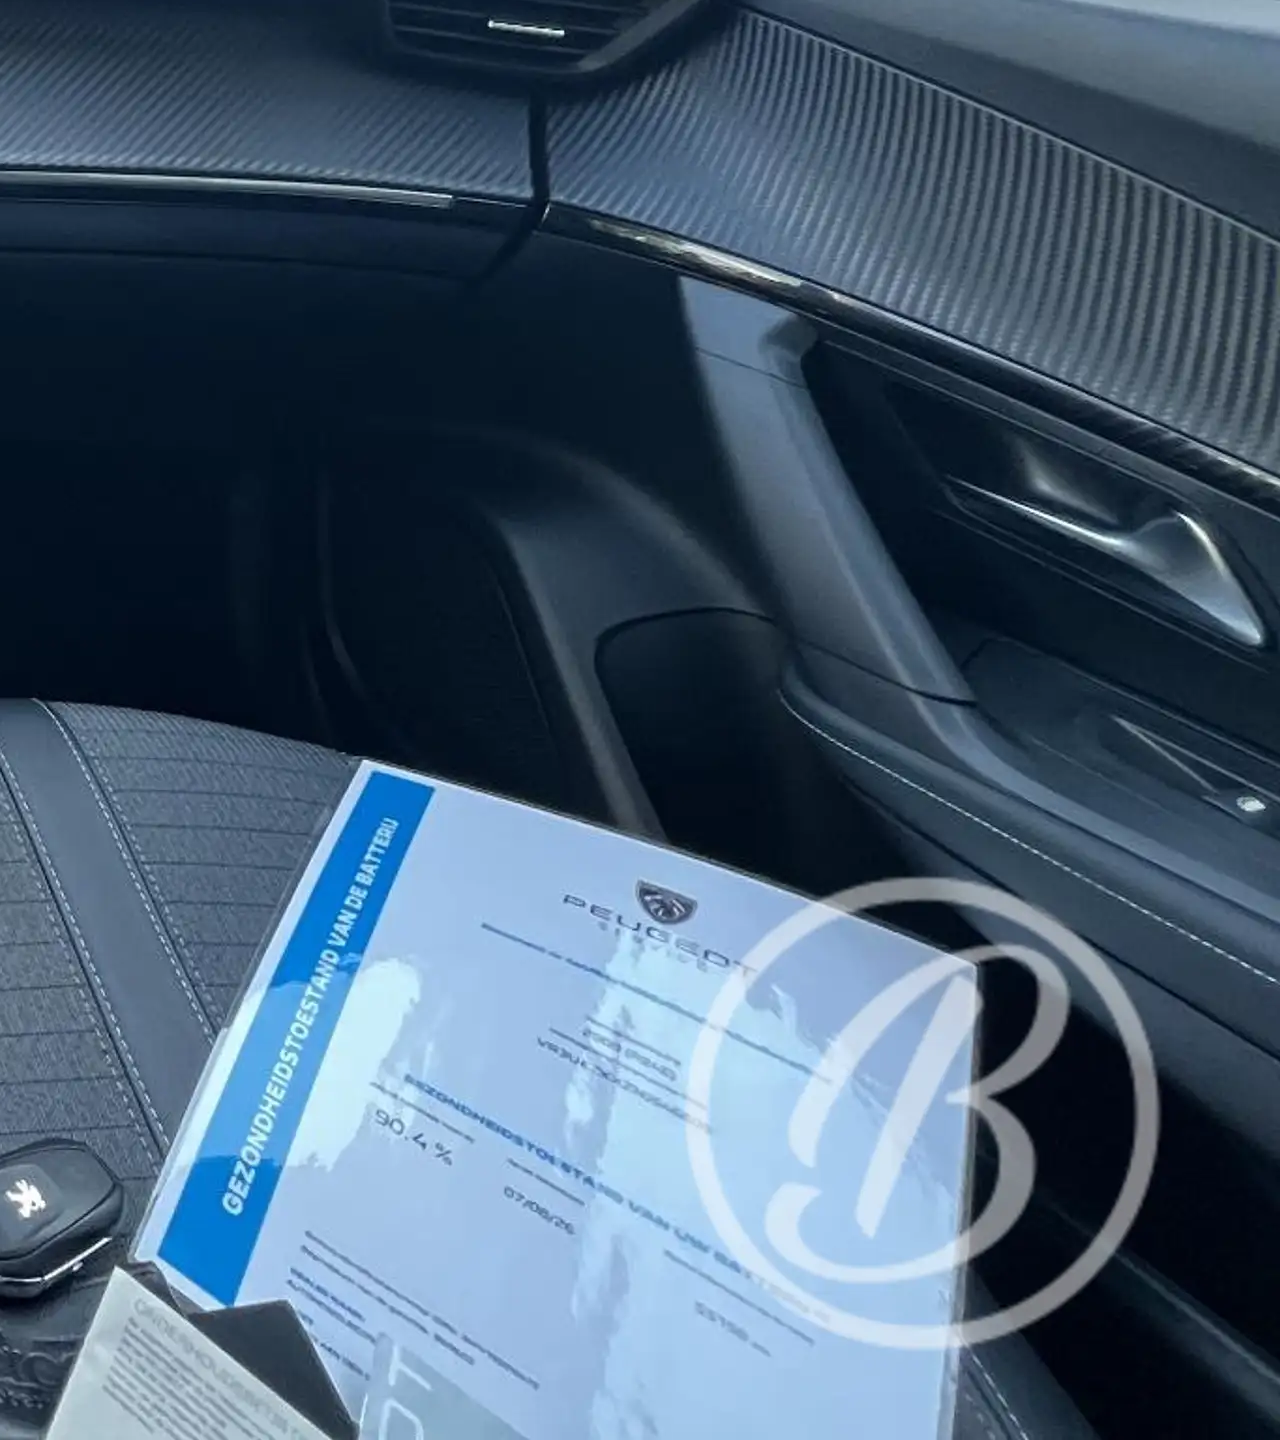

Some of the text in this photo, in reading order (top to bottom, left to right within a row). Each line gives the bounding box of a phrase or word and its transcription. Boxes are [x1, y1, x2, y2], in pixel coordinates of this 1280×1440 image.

[563, 894, 757, 977] PEUGEOT
[222, 942, 340, 1216] GEZONDHEIDSTOESTAND
[326, 907, 359, 948] VAN
[343, 880, 369, 911] DE
[374, 1109, 429, 1150] 90.4
[434, 1142, 453, 1166] %
